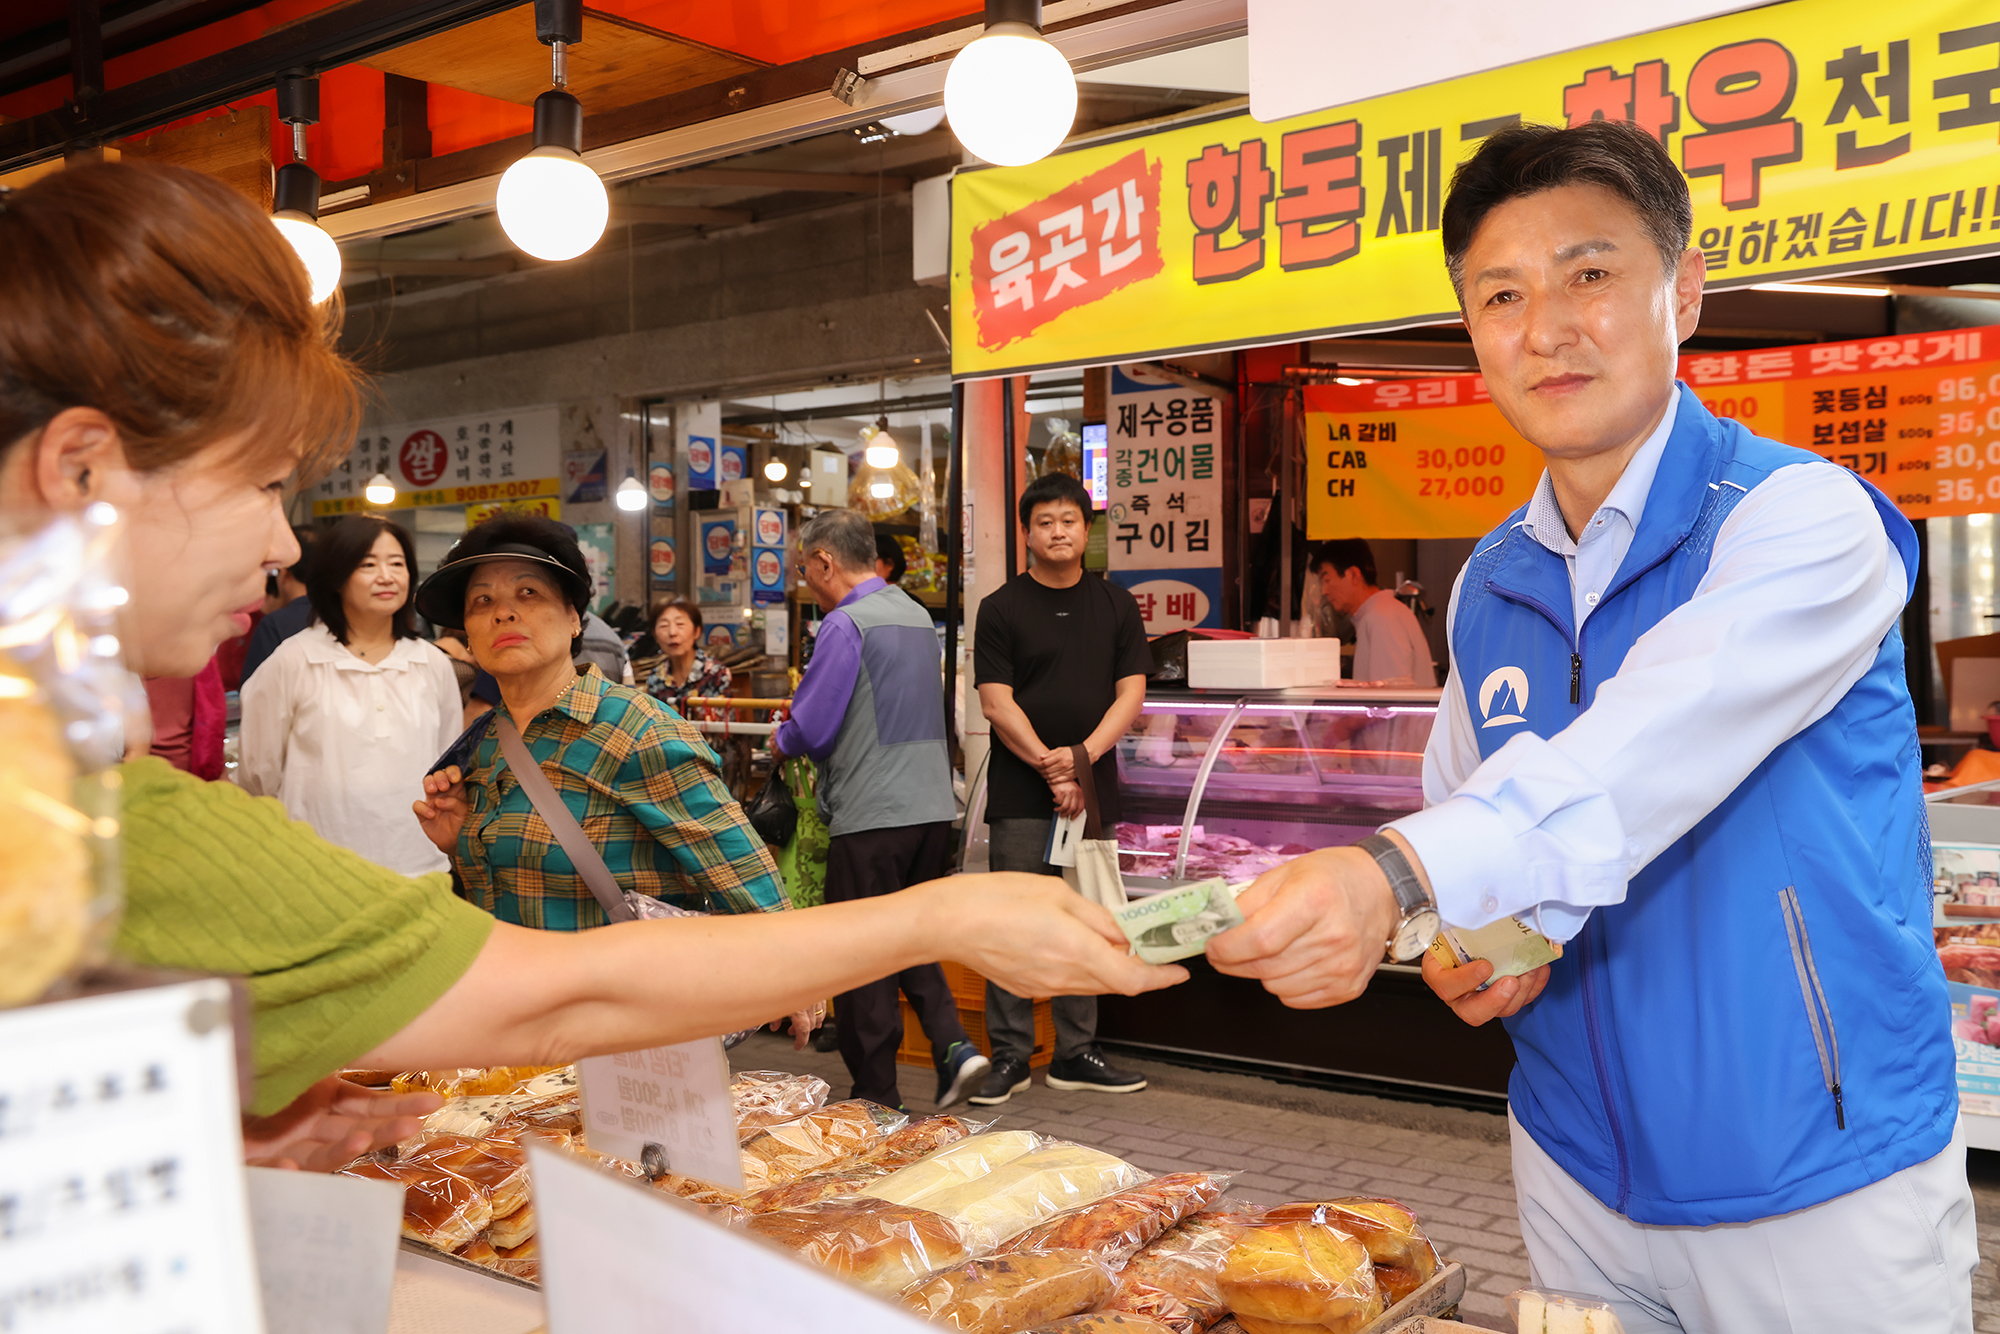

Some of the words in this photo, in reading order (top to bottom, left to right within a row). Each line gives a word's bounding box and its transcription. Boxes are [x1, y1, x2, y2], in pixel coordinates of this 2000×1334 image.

[1185, 119, 1366, 286] 한돈
[1375, 113, 1522, 238] 제
[988, 178, 1145, 312] 육곳간
[1373, 380, 1459, 408] 우리
[1689, 350, 1794, 384] 한돈
[1810, 332, 1982, 375] 맛있게
[1813, 385, 1887, 414] 꽃등심
[1117, 397, 1214, 439] 제수용품
[1327, 423, 1351, 442] LA
[1357, 421, 1397, 442] 갈비
[1813, 418, 1888, 445] 보섭살
[403, 435, 441, 480] 쌀
[1137, 443, 1214, 484] 건어물
[1327, 450, 1367, 469] CAB
[1416, 444, 1506, 473] 30,000
[1822, 452, 1887, 475] 고기
[1327, 478, 1355, 497] CH
[1418, 475, 1505, 500] 27,000
[1131, 492, 1185, 515] 즉석
[1116, 519, 1209, 555] 구이김
[1120, 899, 1171, 922] 10000
